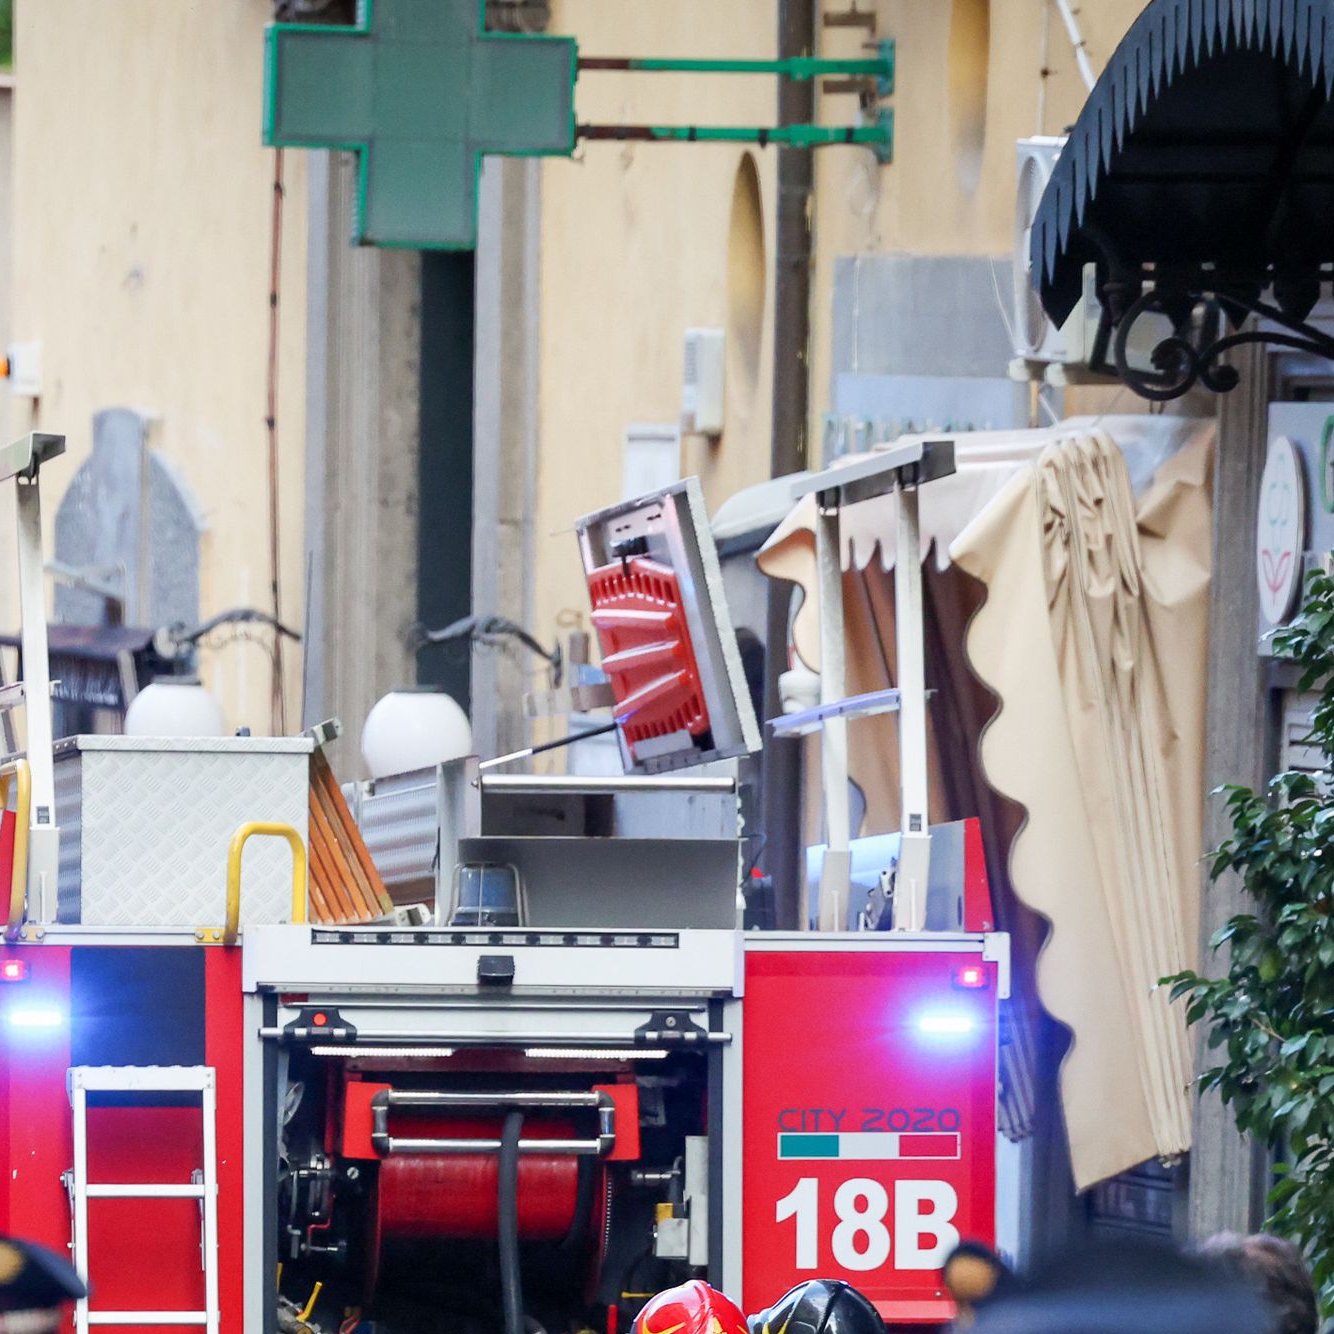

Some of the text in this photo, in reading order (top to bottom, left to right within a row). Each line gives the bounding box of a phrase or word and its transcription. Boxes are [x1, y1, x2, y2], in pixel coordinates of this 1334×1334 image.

[778, 1108, 961, 1131] CITY 2020
[775, 1177, 960, 1271] 18B
